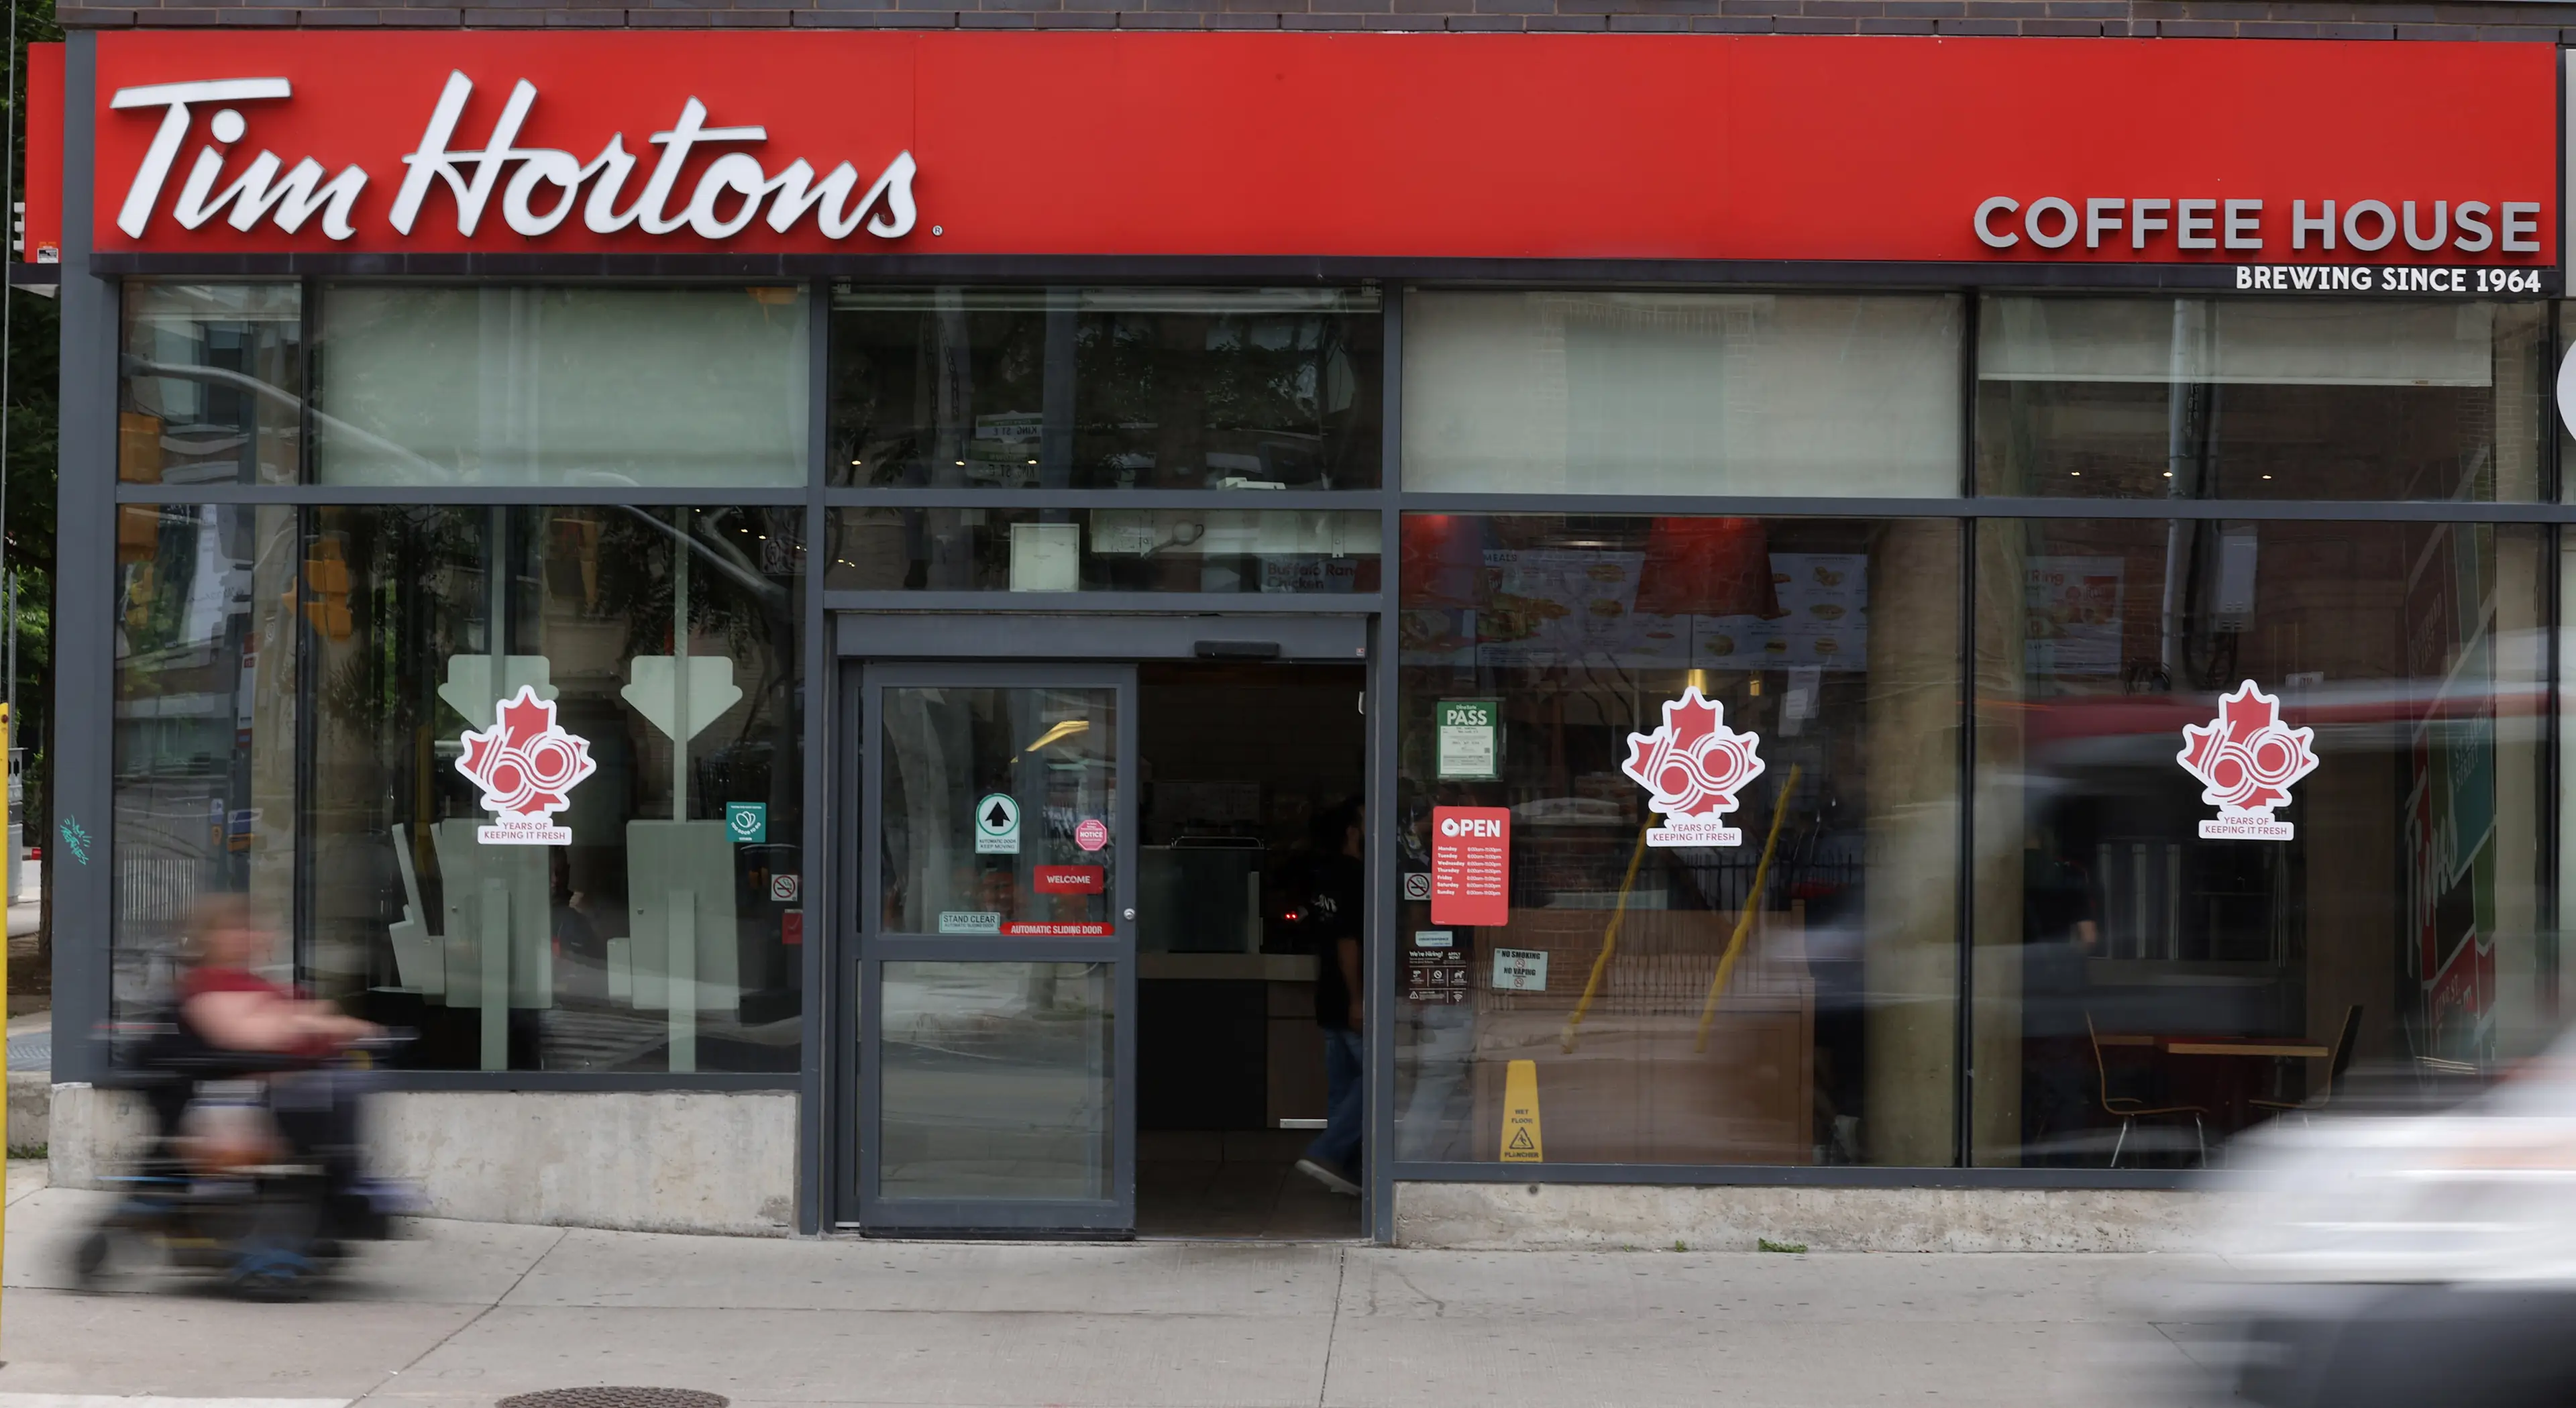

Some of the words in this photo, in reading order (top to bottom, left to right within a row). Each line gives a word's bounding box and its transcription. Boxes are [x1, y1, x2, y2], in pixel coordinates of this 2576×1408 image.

[110, 76, 370, 241] Tim
[388, 69, 918, 239] Hortons
[1974, 195, 2264, 250] COFFEE
[2292, 199, 2541, 254] HOUSE
[2236, 266, 2372, 290] BREWING
[2381, 268, 2467, 292] SINCE
[2476, 268, 2542, 293] 1964
[1268, 563, 1322, 576] Buffalo
[1446, 710, 1488, 726] PASS
[2224, 816, 2254, 825] YEARS
[2257, 817, 2269, 825] OF
[502, 822, 533, 830] YEARS
[535, 822, 548, 830] OF
[1441, 818, 1501, 838] OPEN
[1671, 824, 1702, 832] YEARS
[1704, 824, 1717, 832] OF
[2205, 826, 2245, 834] KEEPING
[2258, 826, 2288, 835] FRESH
[484, 832, 523, 840] KEEPING
[527, 832, 535, 840] IT
[537, 832, 566, 841] FRESH
[1653, 833, 1693, 842] KEEPING
[1695, 833, 1704, 841] IT
[1706, 833, 1735, 842] FRESH
[1046, 875, 1091, 884] WELCOME
[943, 915, 969, 923] STAND
[1011, 925, 1052, 934] AUTOMATIC
[1053, 926, 1081, 934] SLIDING
[1082, 926, 1103, 934] DOOR
[1501, 950, 1511, 958] NO
[1511, 951, 1541, 960] SMOKING
[1513, 968, 1536, 976] VAPING
